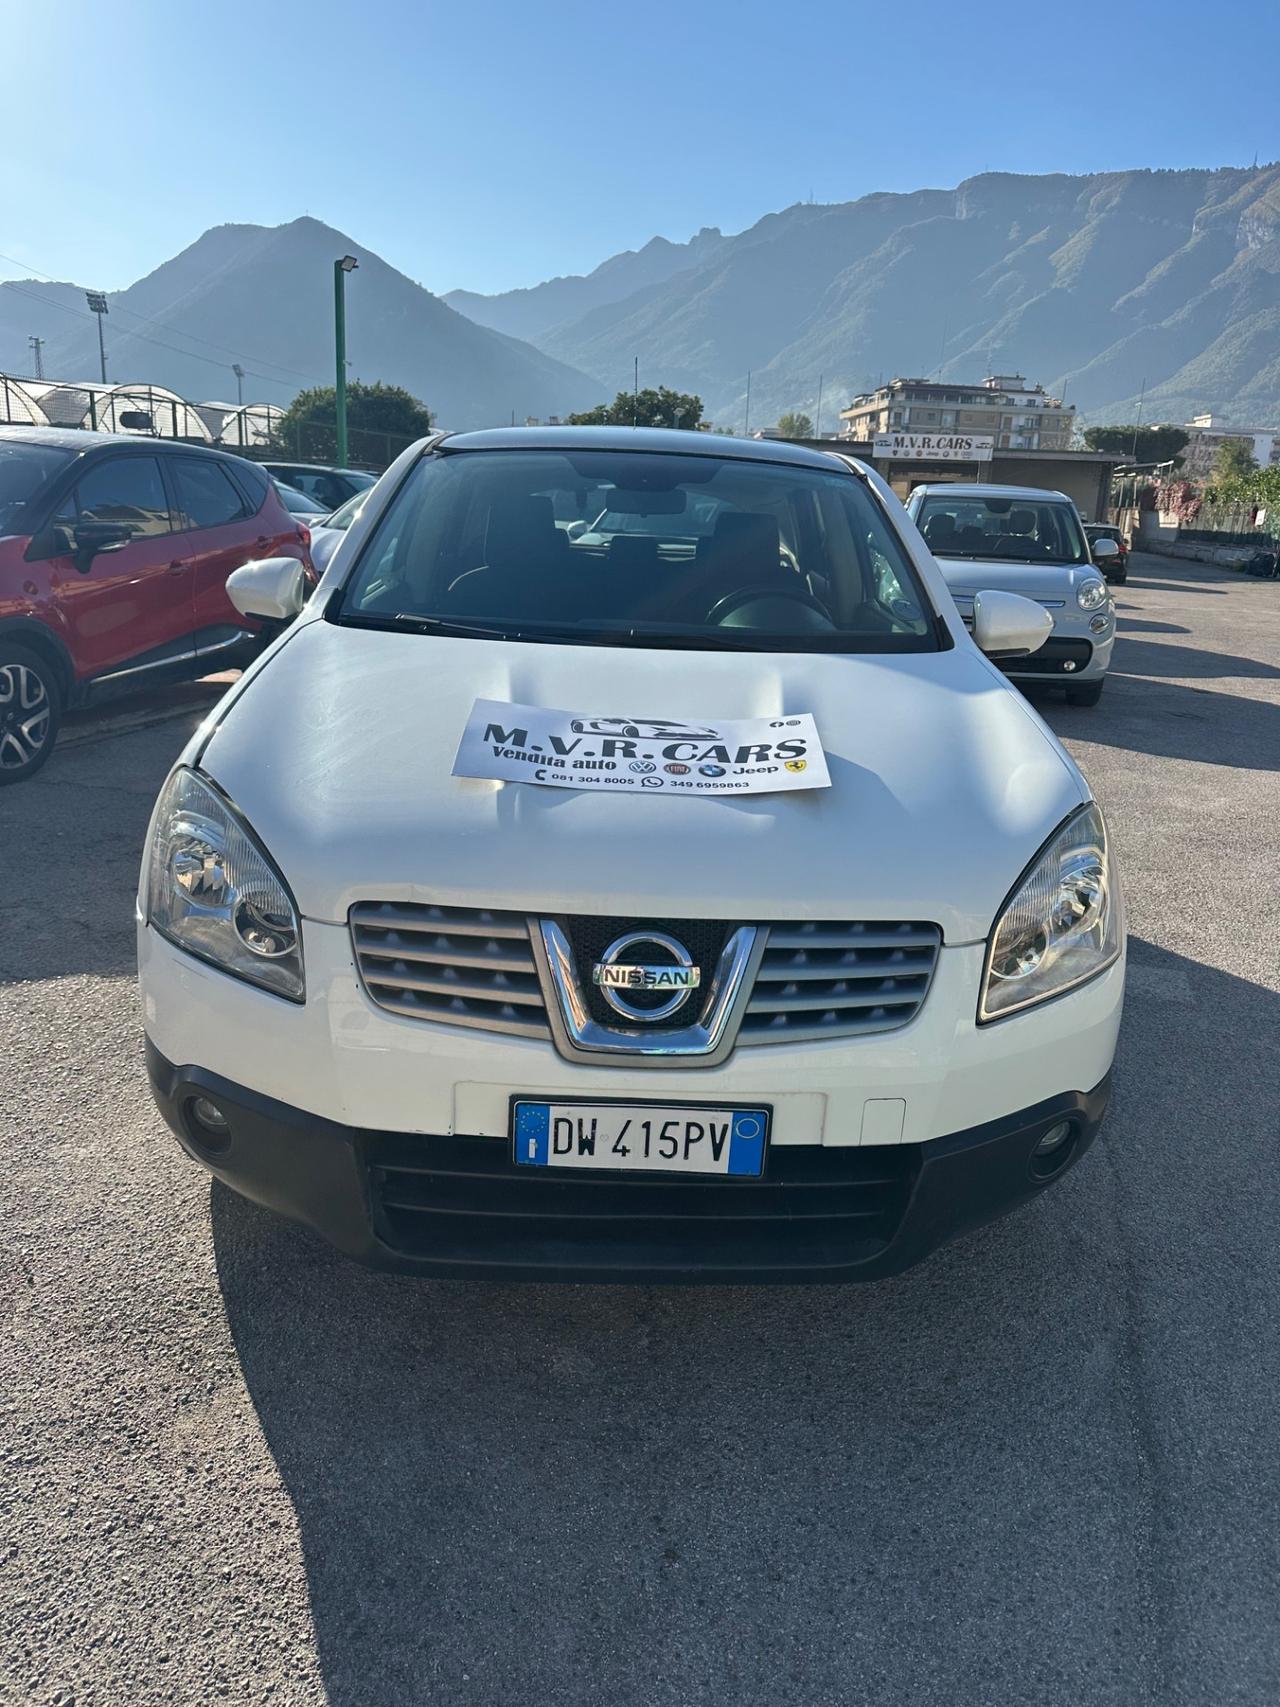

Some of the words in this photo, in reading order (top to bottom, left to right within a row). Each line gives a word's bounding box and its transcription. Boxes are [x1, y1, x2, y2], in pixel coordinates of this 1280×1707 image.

[894, 436, 973, 450] M.V.R.CARS
[492, 745, 566, 768] Vendita
[572, 759, 617, 770] auto
[551, 773, 574, 782] 081
[732, 766, 779, 775] Jeep
[670, 780, 693, 788] 349
[604, 968, 689, 985] NISSAN
[552, 1117, 598, 1156] DW
[611, 1119, 729, 1162] 415PV
